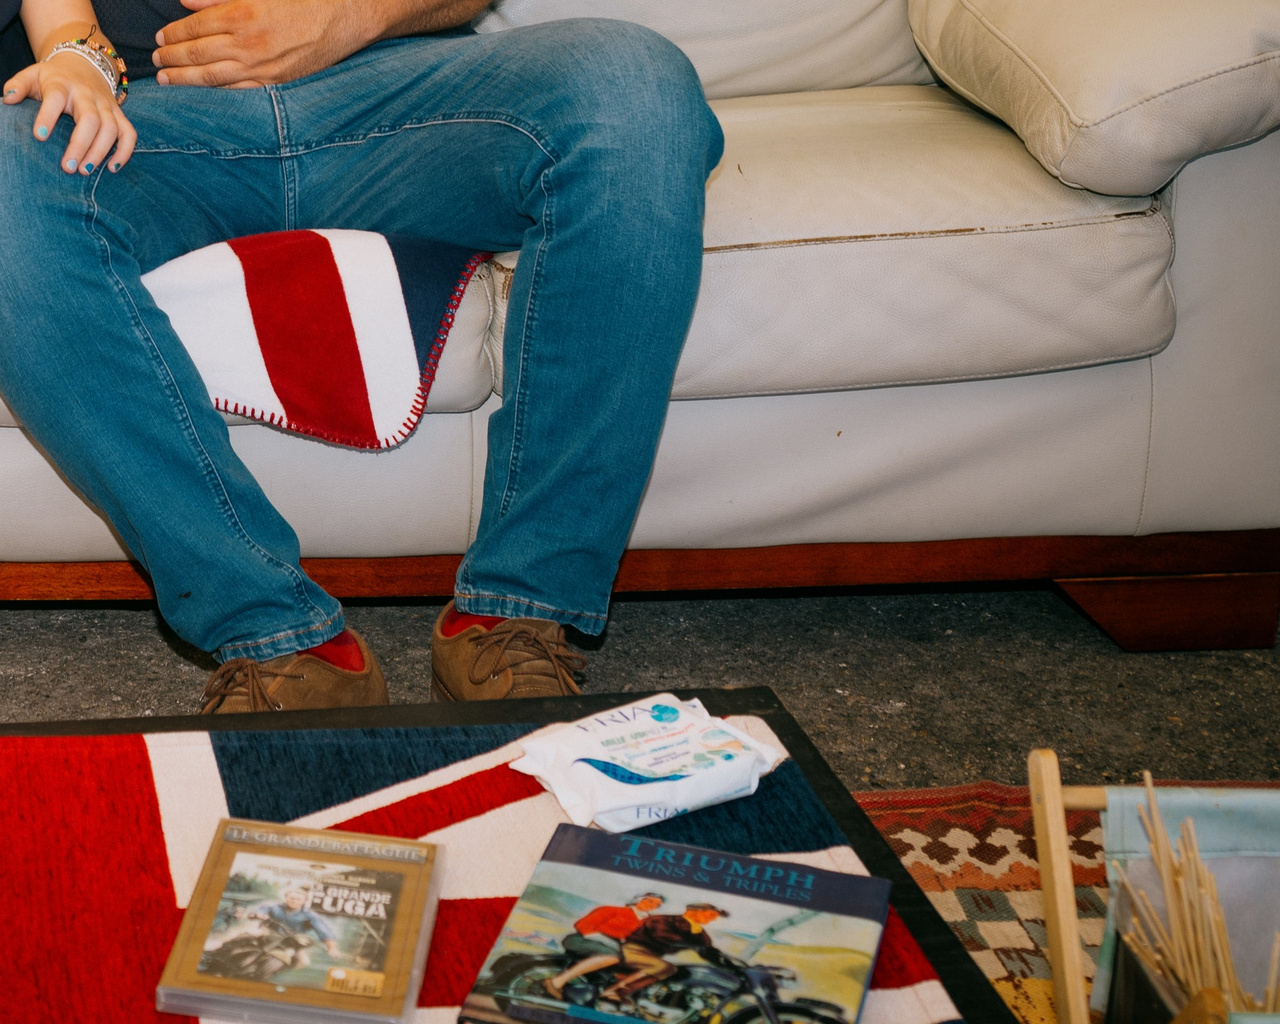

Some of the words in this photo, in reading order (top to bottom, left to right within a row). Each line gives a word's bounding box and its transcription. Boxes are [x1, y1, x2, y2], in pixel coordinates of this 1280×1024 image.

[612, 855, 685, 877] TWINS
[693, 871, 711, 884] &
[721, 876, 812, 902] TRIPLES
[620, 836, 815, 890] TRIUMPH
[304, 891, 387, 920] FUGA
[326, 887, 392, 905] GRANDE
